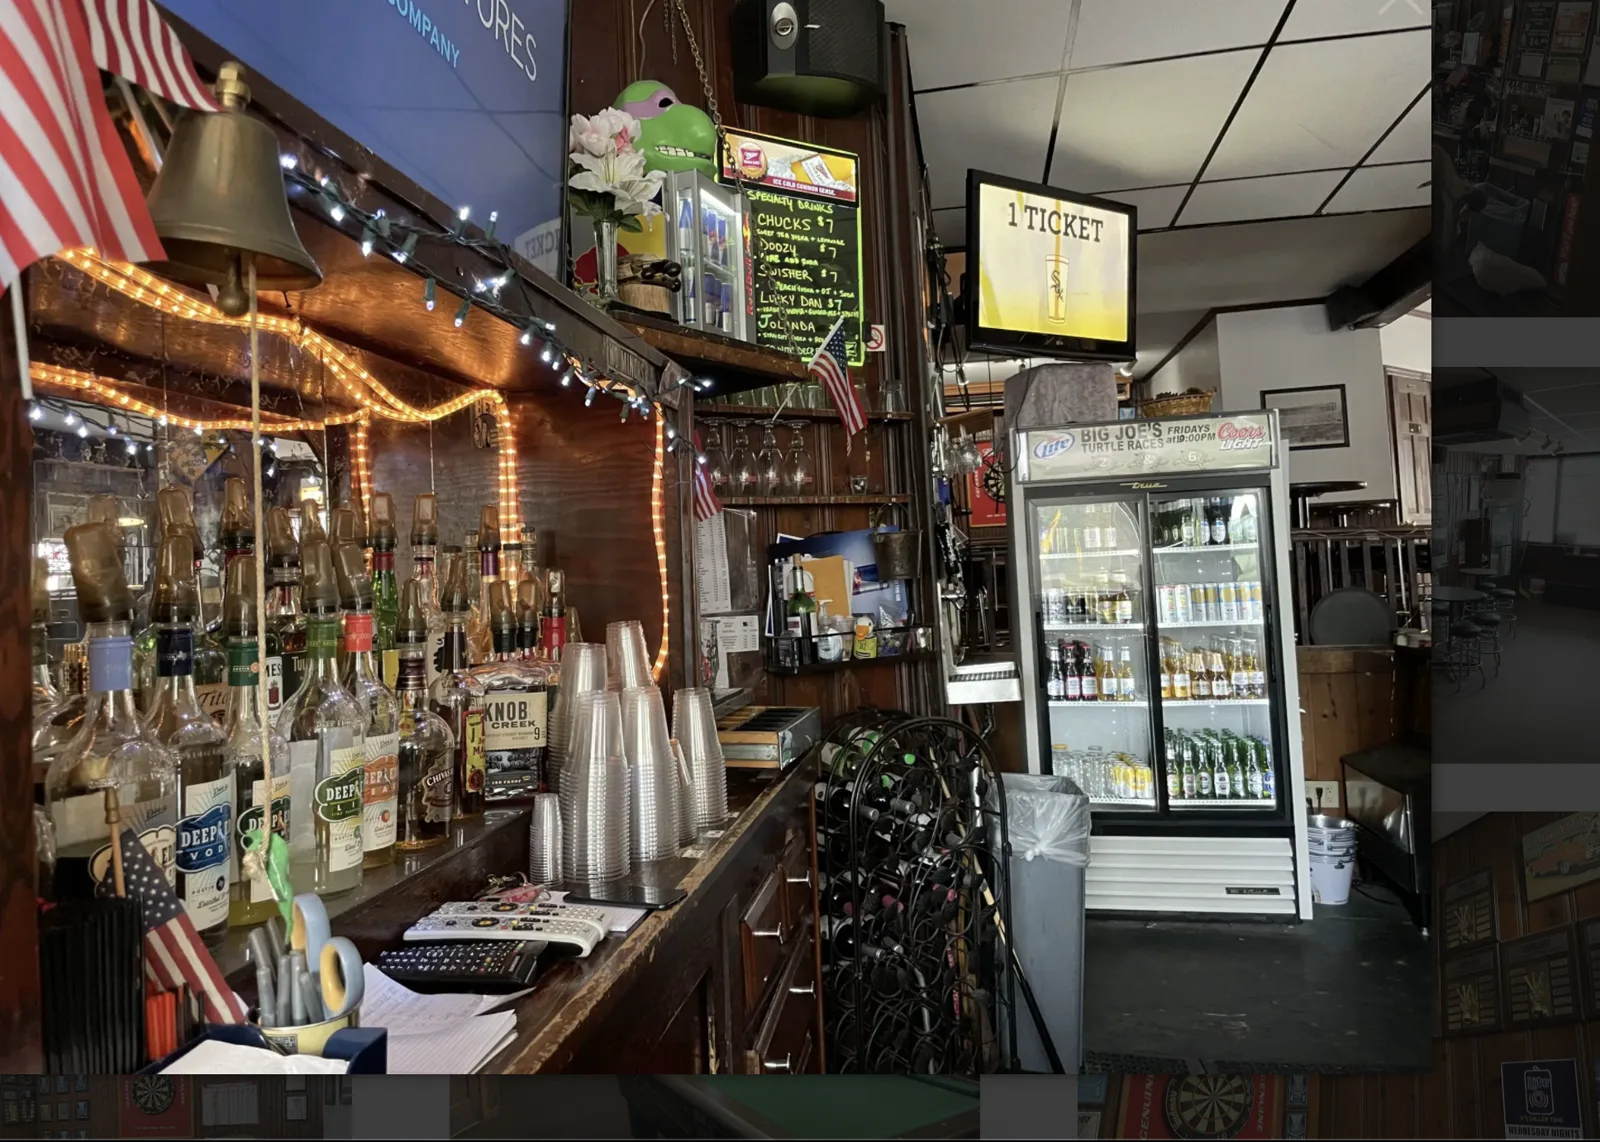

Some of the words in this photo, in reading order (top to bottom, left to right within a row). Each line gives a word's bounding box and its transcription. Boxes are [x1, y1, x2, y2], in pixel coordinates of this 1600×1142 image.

[464, 0, 537, 81] URES
[772, 178, 782, 186] ICE
[783, 180, 796, 188] COLD
[796, 182, 818, 192] COMMON
[747, 190, 793, 212] SPECIALTY
[798, 200, 833, 214] DRINKS
[757, 213, 811, 231] CHUCKS
[1008, 202, 1018, 227] 1
[1024, 205, 1104, 242] TICKET
[757, 265, 813, 281] SWISHER
[801, 295, 822, 308] DAN
[1081, 428, 1109, 443] BIG
[1115, 422, 1163, 440] JOE'S
[1167, 424, 1210, 435] FRIDAYS
[1217, 422, 1265, 440] Coors
[1041, 439, 1070, 458] Lite
[1081, 440, 1124, 453] TURTLE
[1127, 437, 1165, 451] RACES
[1219, 438, 1263, 451] LIGHT
[1188, 452, 1197, 462] 6
[484, 701, 528, 722] KNOB
[491, 720, 536, 729] CREEK
[533, 727, 541, 740] 9
[326, 783, 354, 801] DEEP
[249, 814, 278, 831] DEP
[181, 825, 217, 848] DEEP
[1508, 1126, 1550, 1137] WEDNESDAY
[1551, 1128, 1581, 1139] NIGHTS
